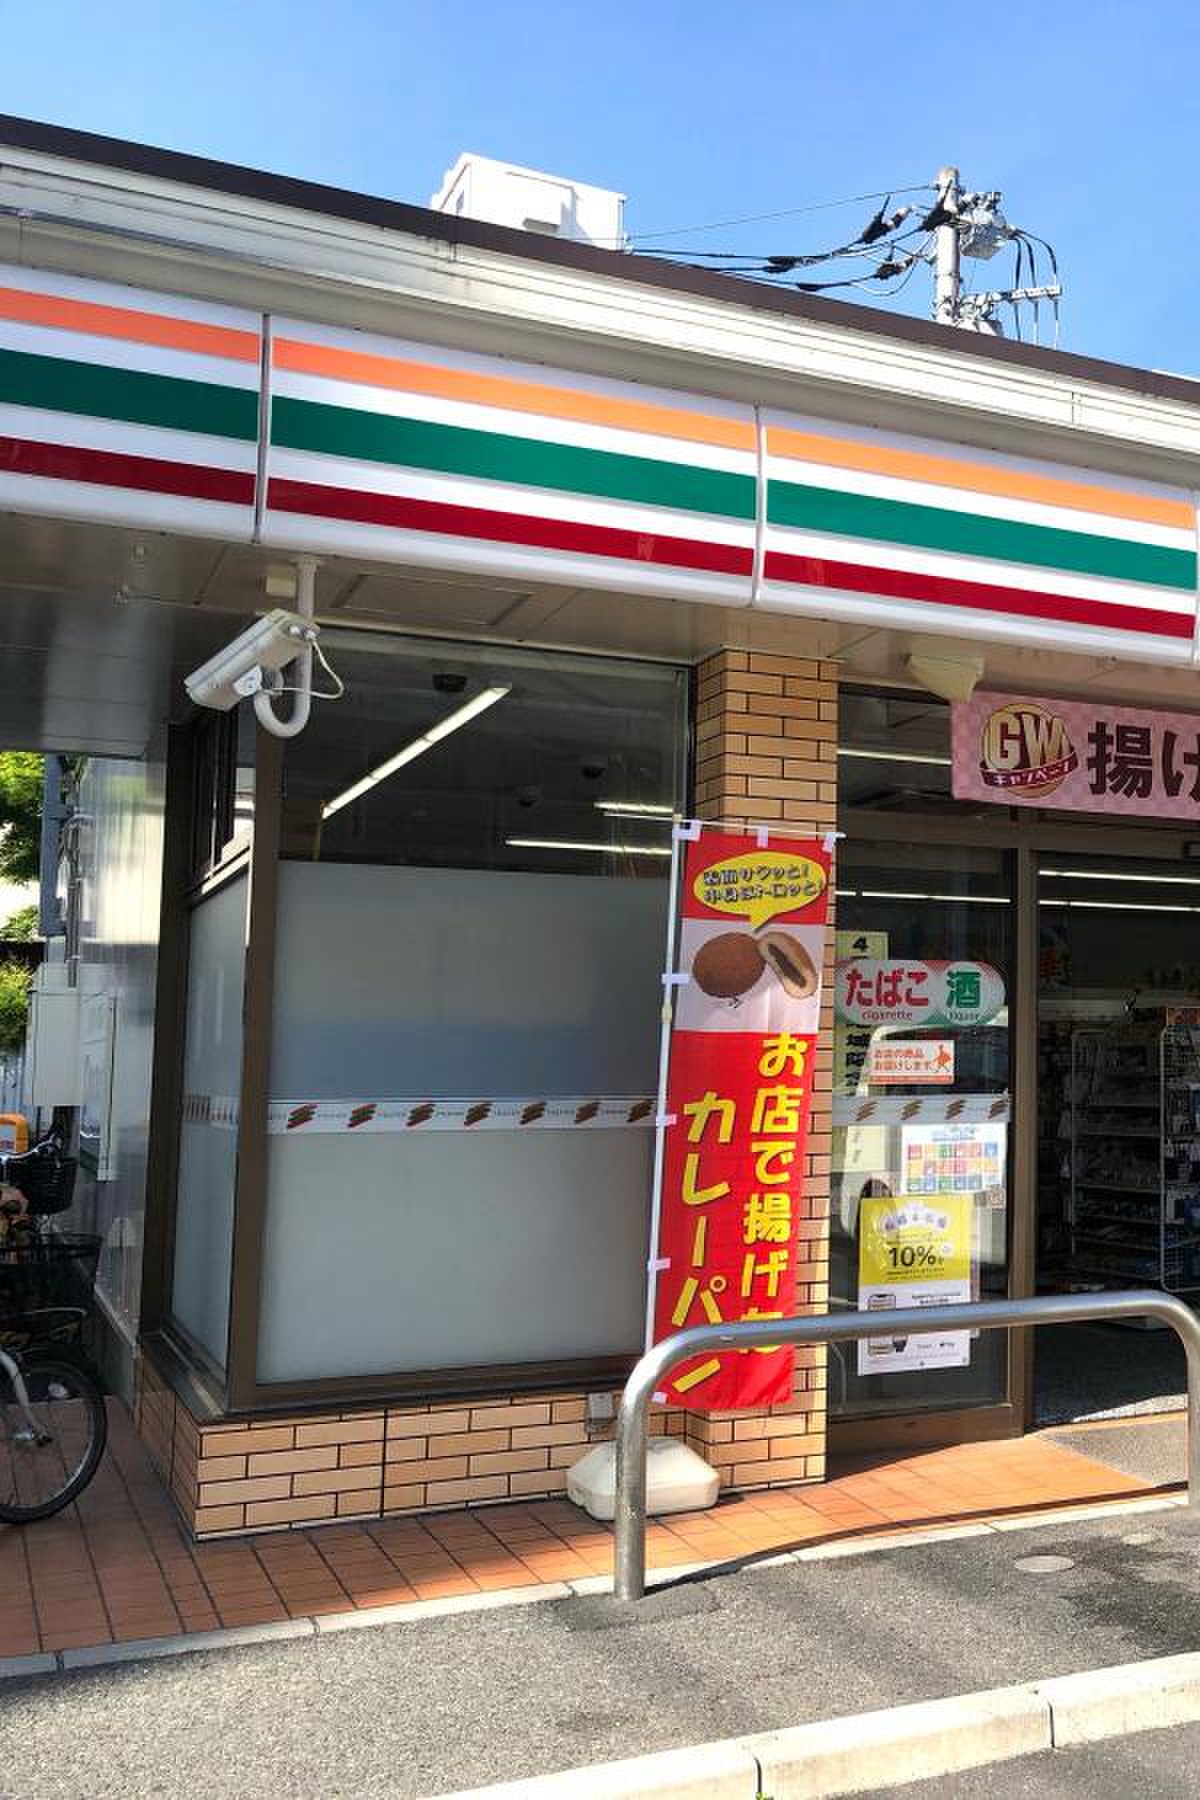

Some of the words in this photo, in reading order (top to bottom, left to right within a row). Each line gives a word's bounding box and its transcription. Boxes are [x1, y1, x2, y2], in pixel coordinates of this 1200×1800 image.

[989, 710, 1074, 770] GW
[844, 967, 929, 1008] たばこ
[945, 970, 982, 1009] 酒
[888, 1245, 937, 1269] 10%
